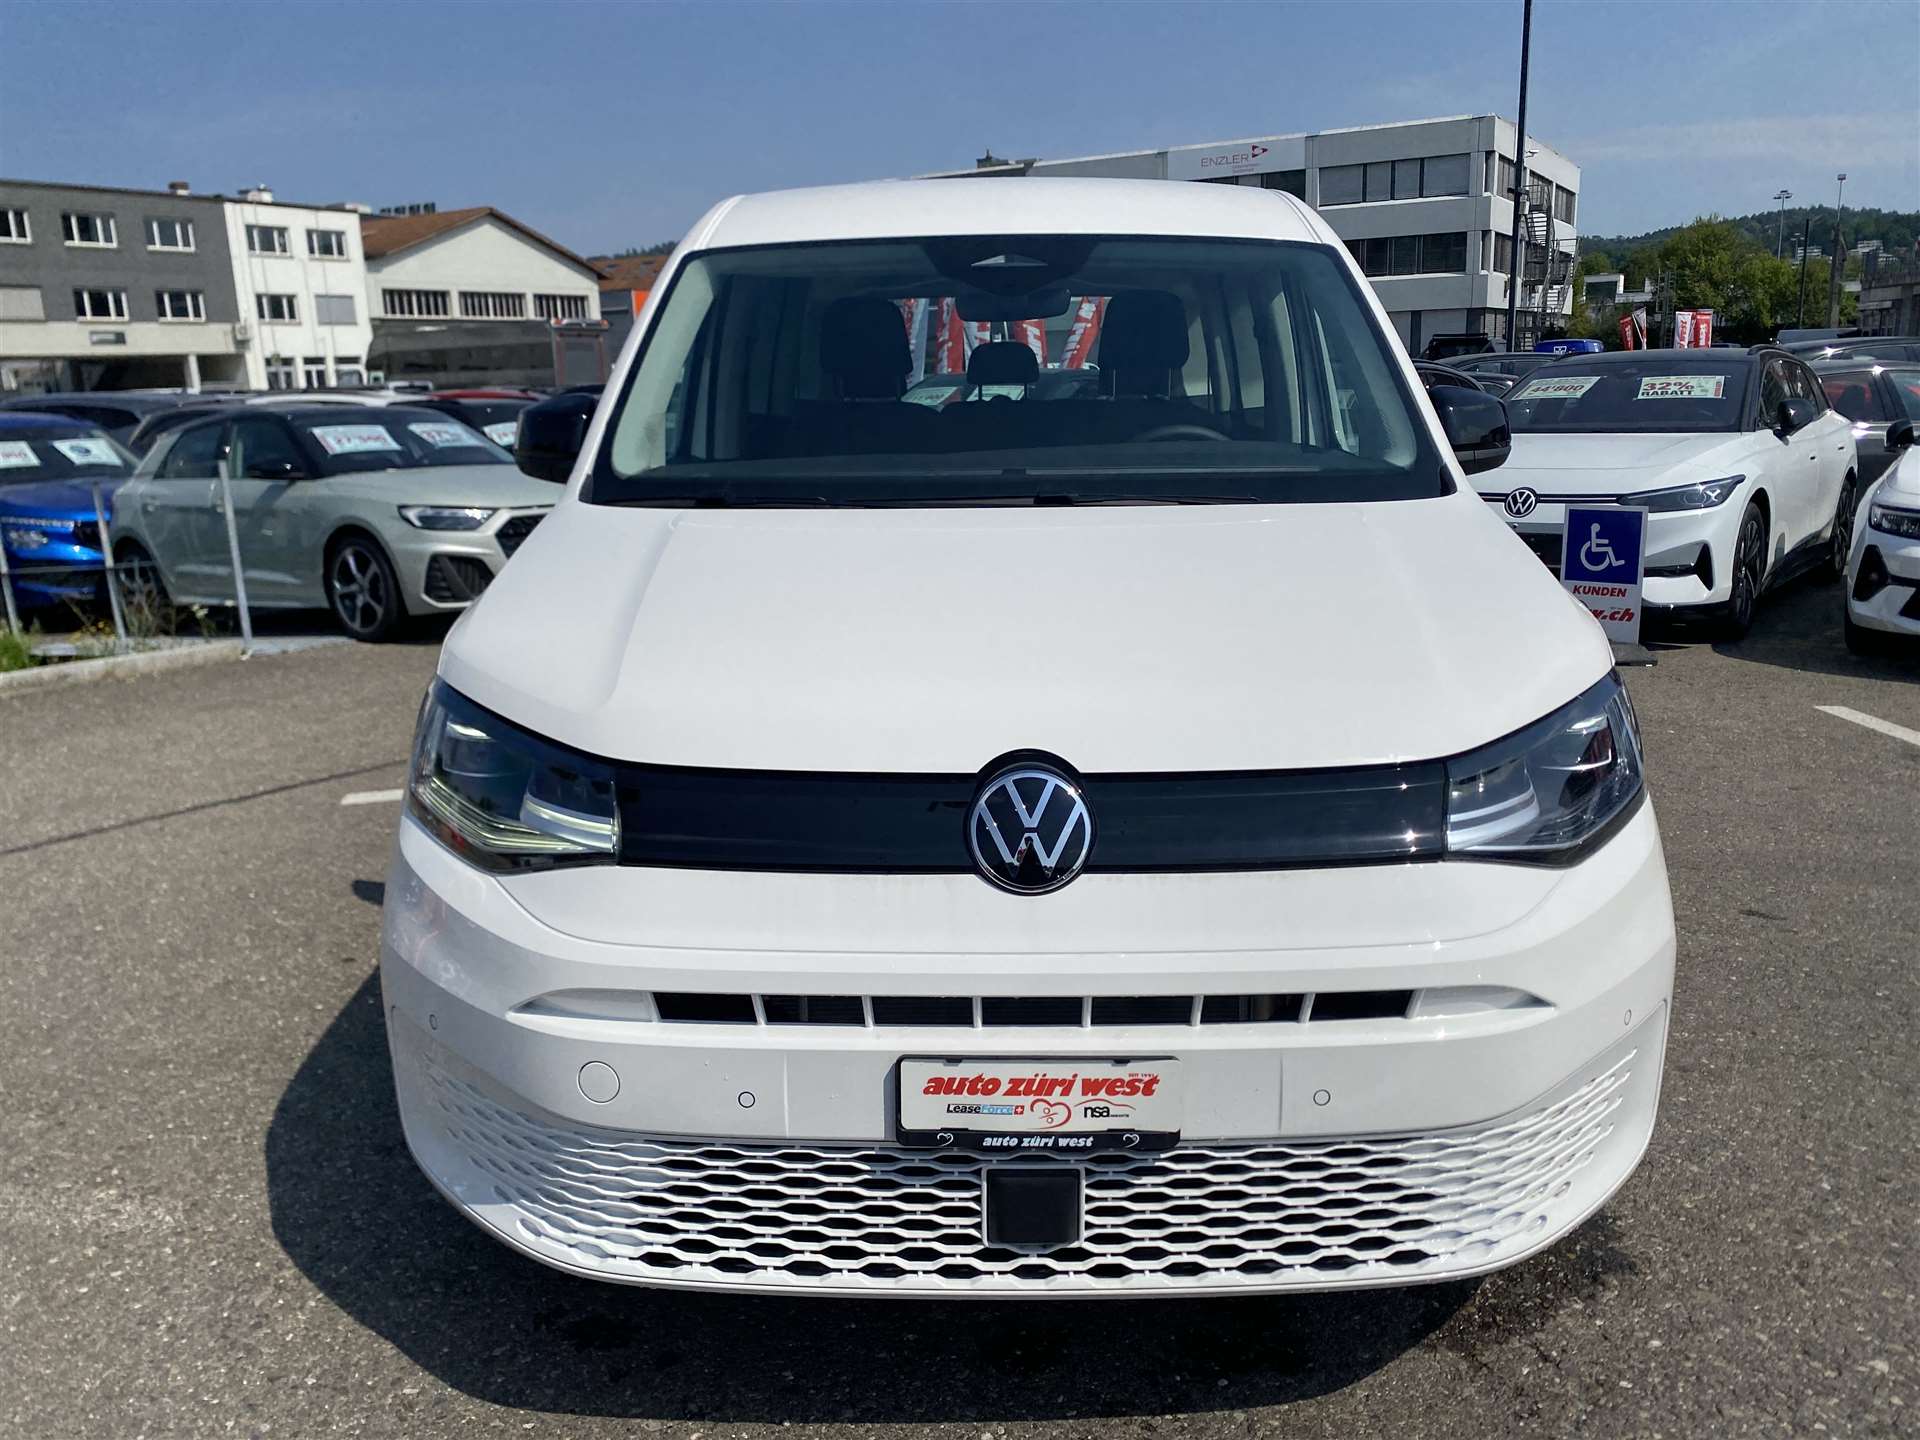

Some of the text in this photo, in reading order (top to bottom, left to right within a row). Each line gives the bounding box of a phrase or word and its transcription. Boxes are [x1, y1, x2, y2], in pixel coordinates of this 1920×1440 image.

[1201, 154, 1249, 168] ENZLER
[1643, 381, 1695, 391] 32%
[1572, 585, 1628, 597] KUNDEN
[923, 1073, 1160, 1096] auto züri west
[1084, 1106, 1110, 1118] nsa
[983, 1136, 1094, 1147] auto züri west
